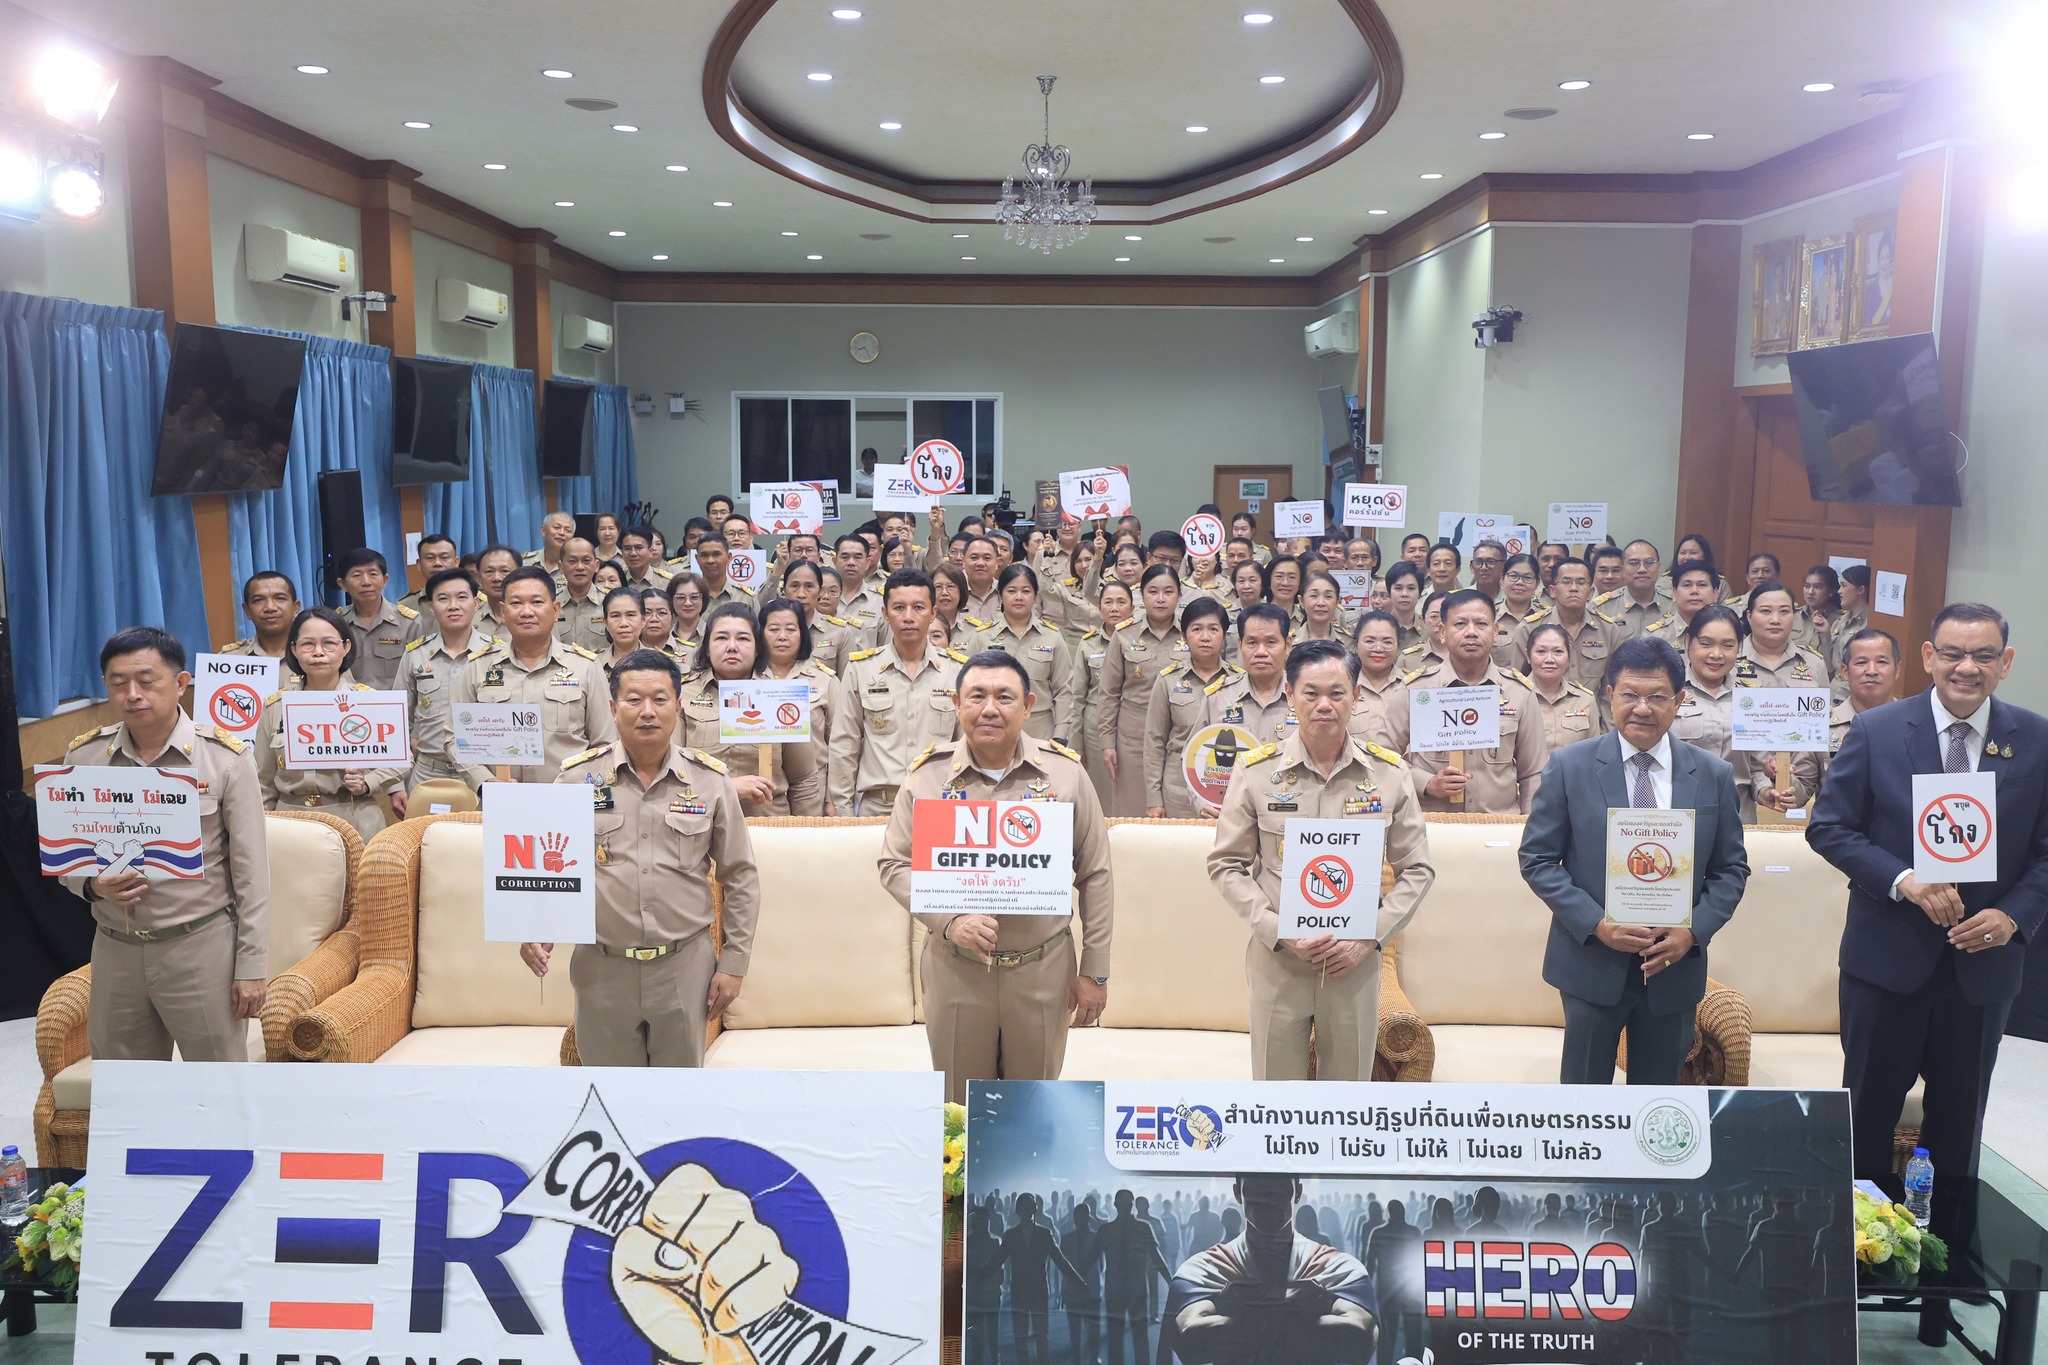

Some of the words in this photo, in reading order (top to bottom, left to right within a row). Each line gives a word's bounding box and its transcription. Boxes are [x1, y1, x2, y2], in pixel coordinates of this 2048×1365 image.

[917, 454, 952, 480] โกง
[1351, 495, 1383, 508] หยุด
[1186, 526, 1215, 546] โกง
[208, 662, 232, 674] NO
[235, 662, 267, 676] GIFT
[308, 745, 388, 755] CORRUPTION
[47, 786, 85, 802] ไม่ทำ
[93, 787, 134, 804] ไม่ทน
[142, 789, 187, 805] ไม่เฉย
[1953, 802, 1970, 811] หยุด
[72, 821, 161, 835] รวมไทยต้านโกง
[1621, 828, 1633, 836] No
[1634, 828, 1650, 837] Gift
[1652, 828, 1679, 839] Policy
[1926, 811, 1977, 844] โกง
[1300, 832, 1323, 845] NO
[1327, 832, 1360, 845] GIFT
[937, 852, 979, 868] GIFT
[985, 853, 1051, 869] POLICY
[500, 879, 576, 889] CORRUPTION
[1297, 916, 1351, 928] POLICY
[1224, 1100, 1632, 1132] สำนักงานการปฏิรูปที่ดินเพื่อเกษตรกรรม
[1116, 1141, 1180, 1150] TOLERANCE
[1264, 1134, 1319, 1155] ไม่โกง
[1339, 1136, 1385, 1157] ไม่รับ
[1406, 1137, 1448, 1158] ไม่ให้
[1467, 1138, 1522, 1159] ไม่เฉย
[1542, 1140, 1602, 1161] ไม่กลัว
[1424, 1240, 1637, 1321] HERO
[1458, 1332, 1483, 1349] OF
[1488, 1332, 1525, 1349] THE
[1530, 1333, 1595, 1351] TRUTH
